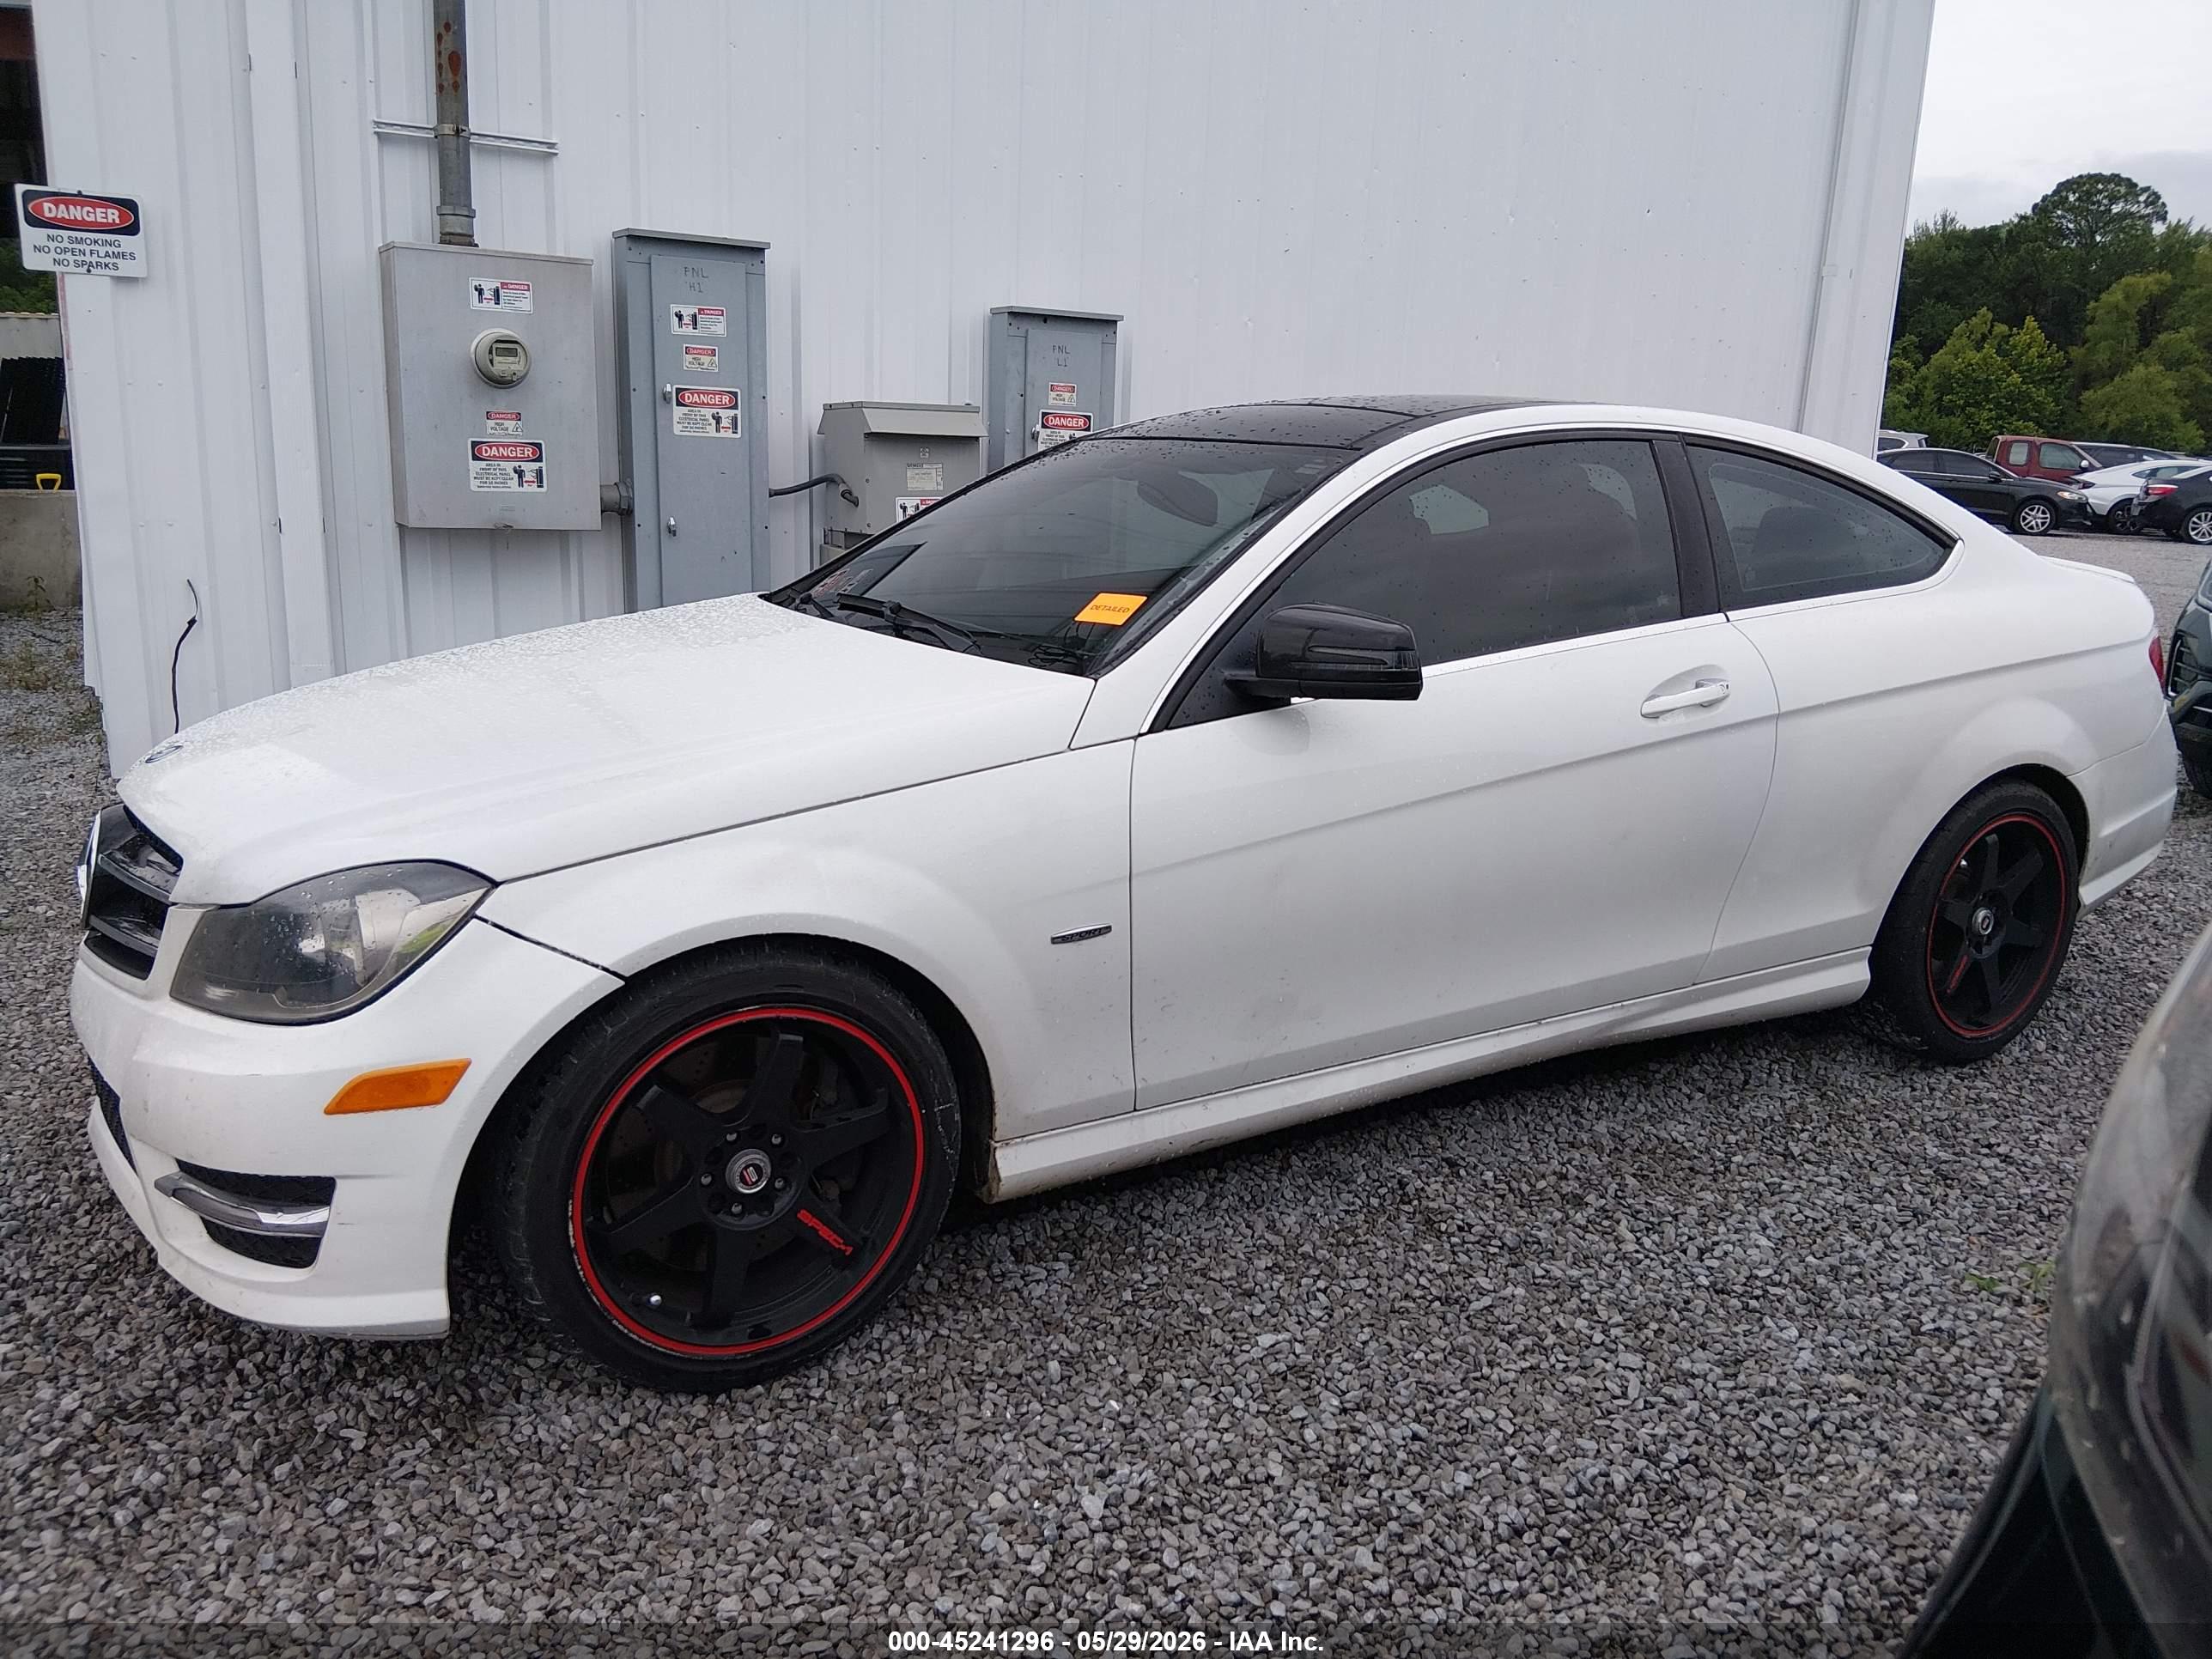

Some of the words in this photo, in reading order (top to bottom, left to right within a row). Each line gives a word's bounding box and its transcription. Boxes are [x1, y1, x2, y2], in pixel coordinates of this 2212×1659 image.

[43, 203, 120, 224] DANGER
[46, 234, 64, 244] NO
[67, 236, 122, 248] SMOKING
[33, 245, 51, 254] NO
[54, 246, 86, 257] OPEN
[89, 249, 137, 261] FLAMES
[53, 258, 70, 268] NO
[73, 259, 119, 270] SPARKS
[684, 393, 730, 404] DANGER
[1048, 416, 1085, 427] DANGER
[482, 447, 533, 458] DANGER
